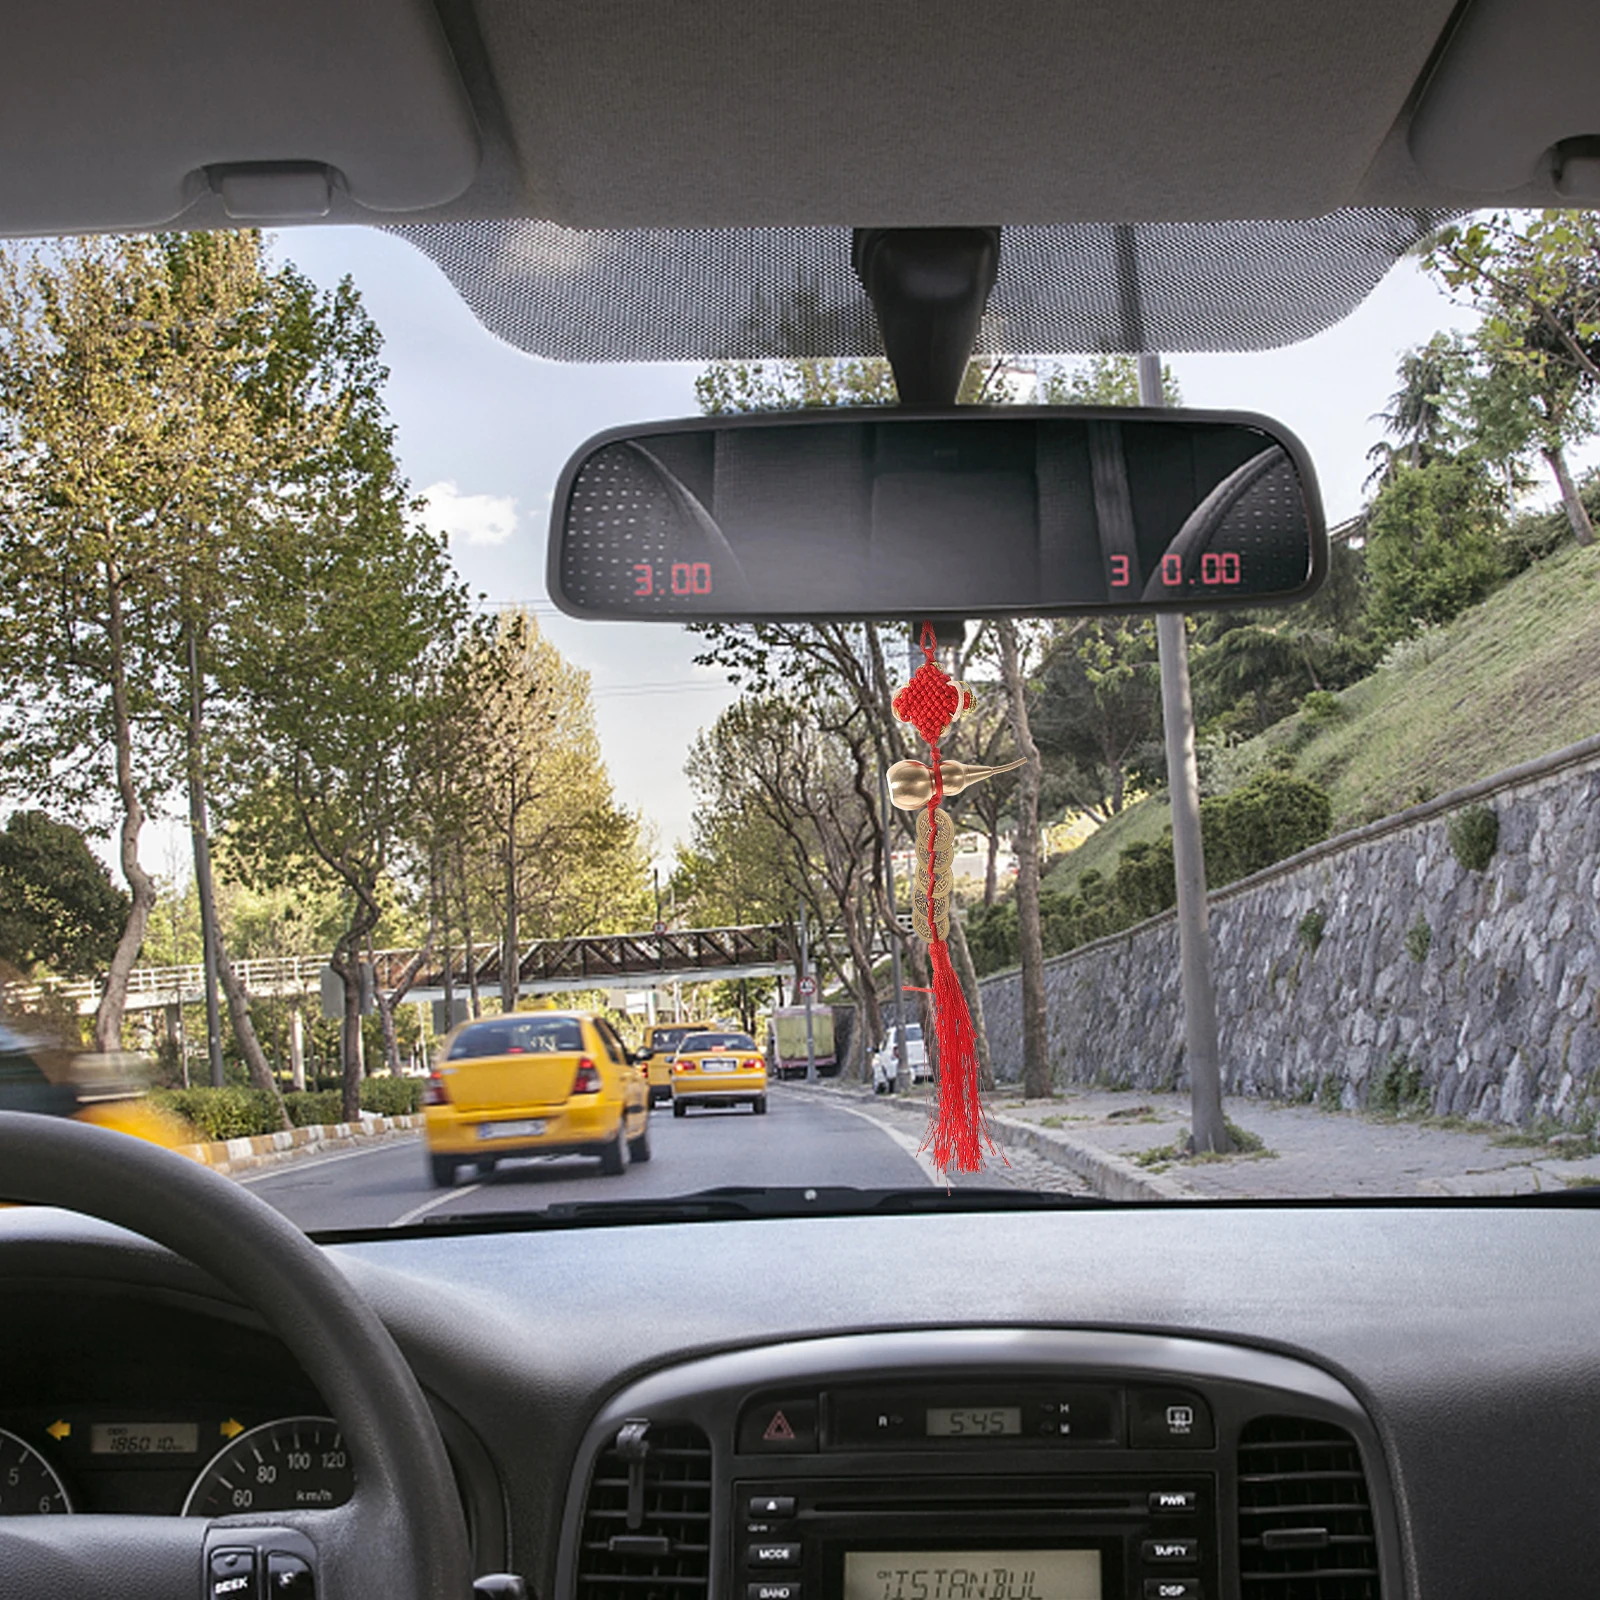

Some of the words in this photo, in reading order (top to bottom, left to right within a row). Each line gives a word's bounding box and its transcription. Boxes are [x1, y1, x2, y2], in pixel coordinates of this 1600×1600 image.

[634, 563, 711, 595] 3.00
[950, 1411, 1004, 1434] 5:45
[287, 1452, 311, 1470] 100
[321, 1451, 346, 1469] 120
[8, 1467, 20, 1486] 5
[256, 1465, 277, 1483] 80
[39, 1495, 51, 1513] 6
[232, 1489, 253, 1507] 60
[296, 1490, 333, 1501] km/h
[1160, 1495, 1186, 1506] PWR
[759, 1549, 789, 1559] MODE
[760, 1588, 790, 1598] BAND
[893, 1569, 1042, 1600] ISTANBUL
